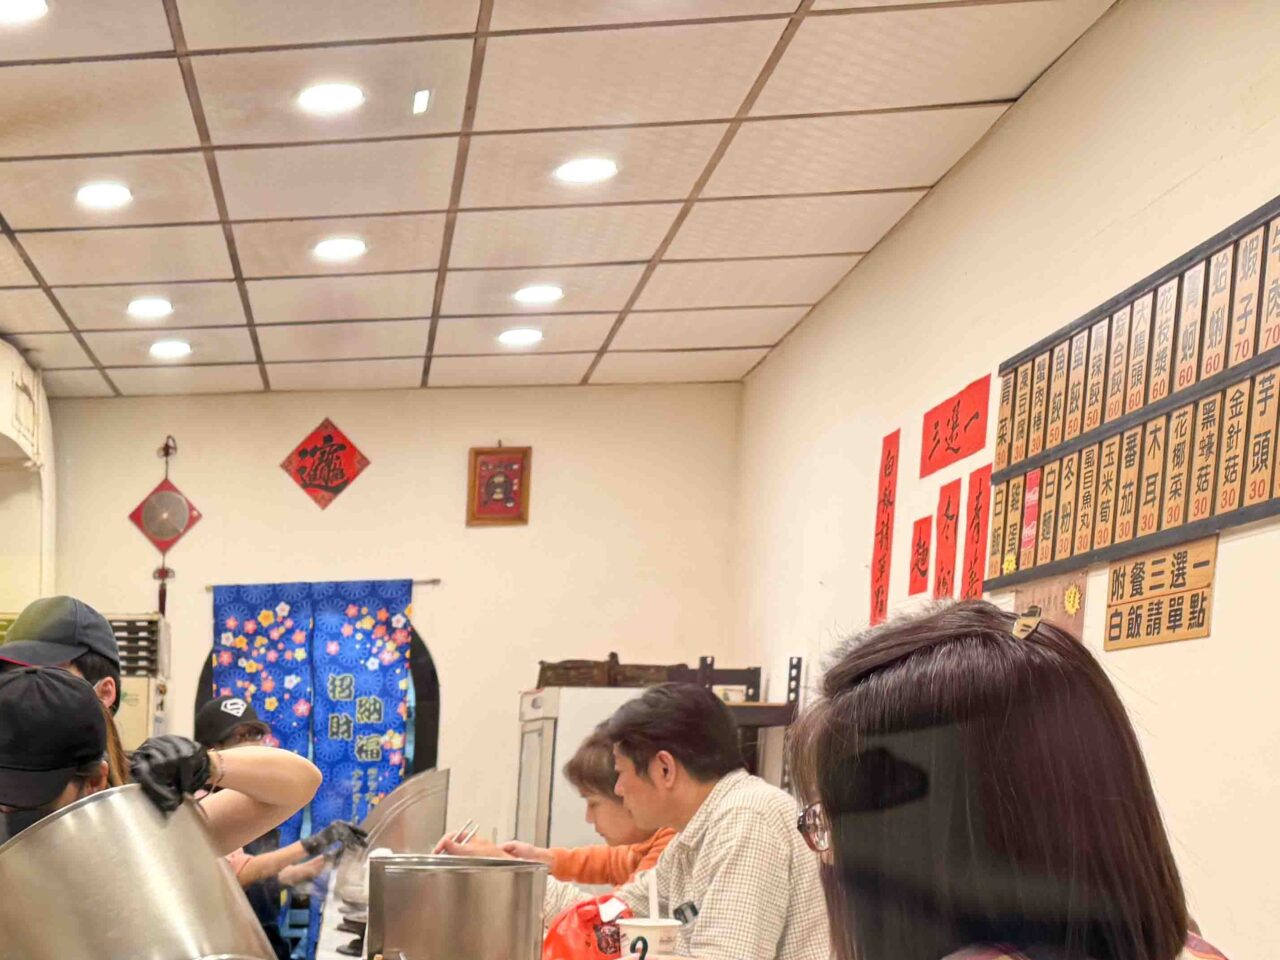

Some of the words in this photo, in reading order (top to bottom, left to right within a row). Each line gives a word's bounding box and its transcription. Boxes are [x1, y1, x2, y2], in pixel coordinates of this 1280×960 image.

[1236, 235, 1260, 336] 蝦子
[1234, 339, 1250, 362] 70
[1069, 334, 1085, 415] 蛋餃
[1205, 354, 1220, 375] 60
[1050, 349, 1066, 425] 魚餃
[1178, 366, 1193, 388] 60
[1152, 379, 1166, 400] 60
[1107, 400, 1120, 419] 60
[1128, 390, 1141, 411] 60
[1067, 420, 1079, 436] 50
[1086, 412, 1099, 429] 50
[1250, 373, 1276, 475] 芋頭
[1049, 426, 1060, 444] 50
[1222, 388, 1245, 487] 金針菇
[1169, 410, 1188, 500] 花椰菜
[1120, 432, 1138, 516] 蕃茄
[1143, 424, 1162, 508] 木耳
[1100, 441, 1116, 524] 玉米筍
[1248, 478, 1266, 500] 30
[1193, 497, 1208, 517] 30
[1220, 487, 1236, 509] 30
[1141, 513, 1154, 531] 30
[1166, 504, 1180, 524] 30
[1097, 527, 1109, 546] 30
[1118, 521, 1131, 539] 30
[1058, 538, 1069, 554] 30
[1077, 534, 1088, 551] 30
[1040, 545, 1050, 562] 30
[1110, 550, 1210, 602] 附餐三選一
[1108, 590, 1208, 642] 白飯請單點
